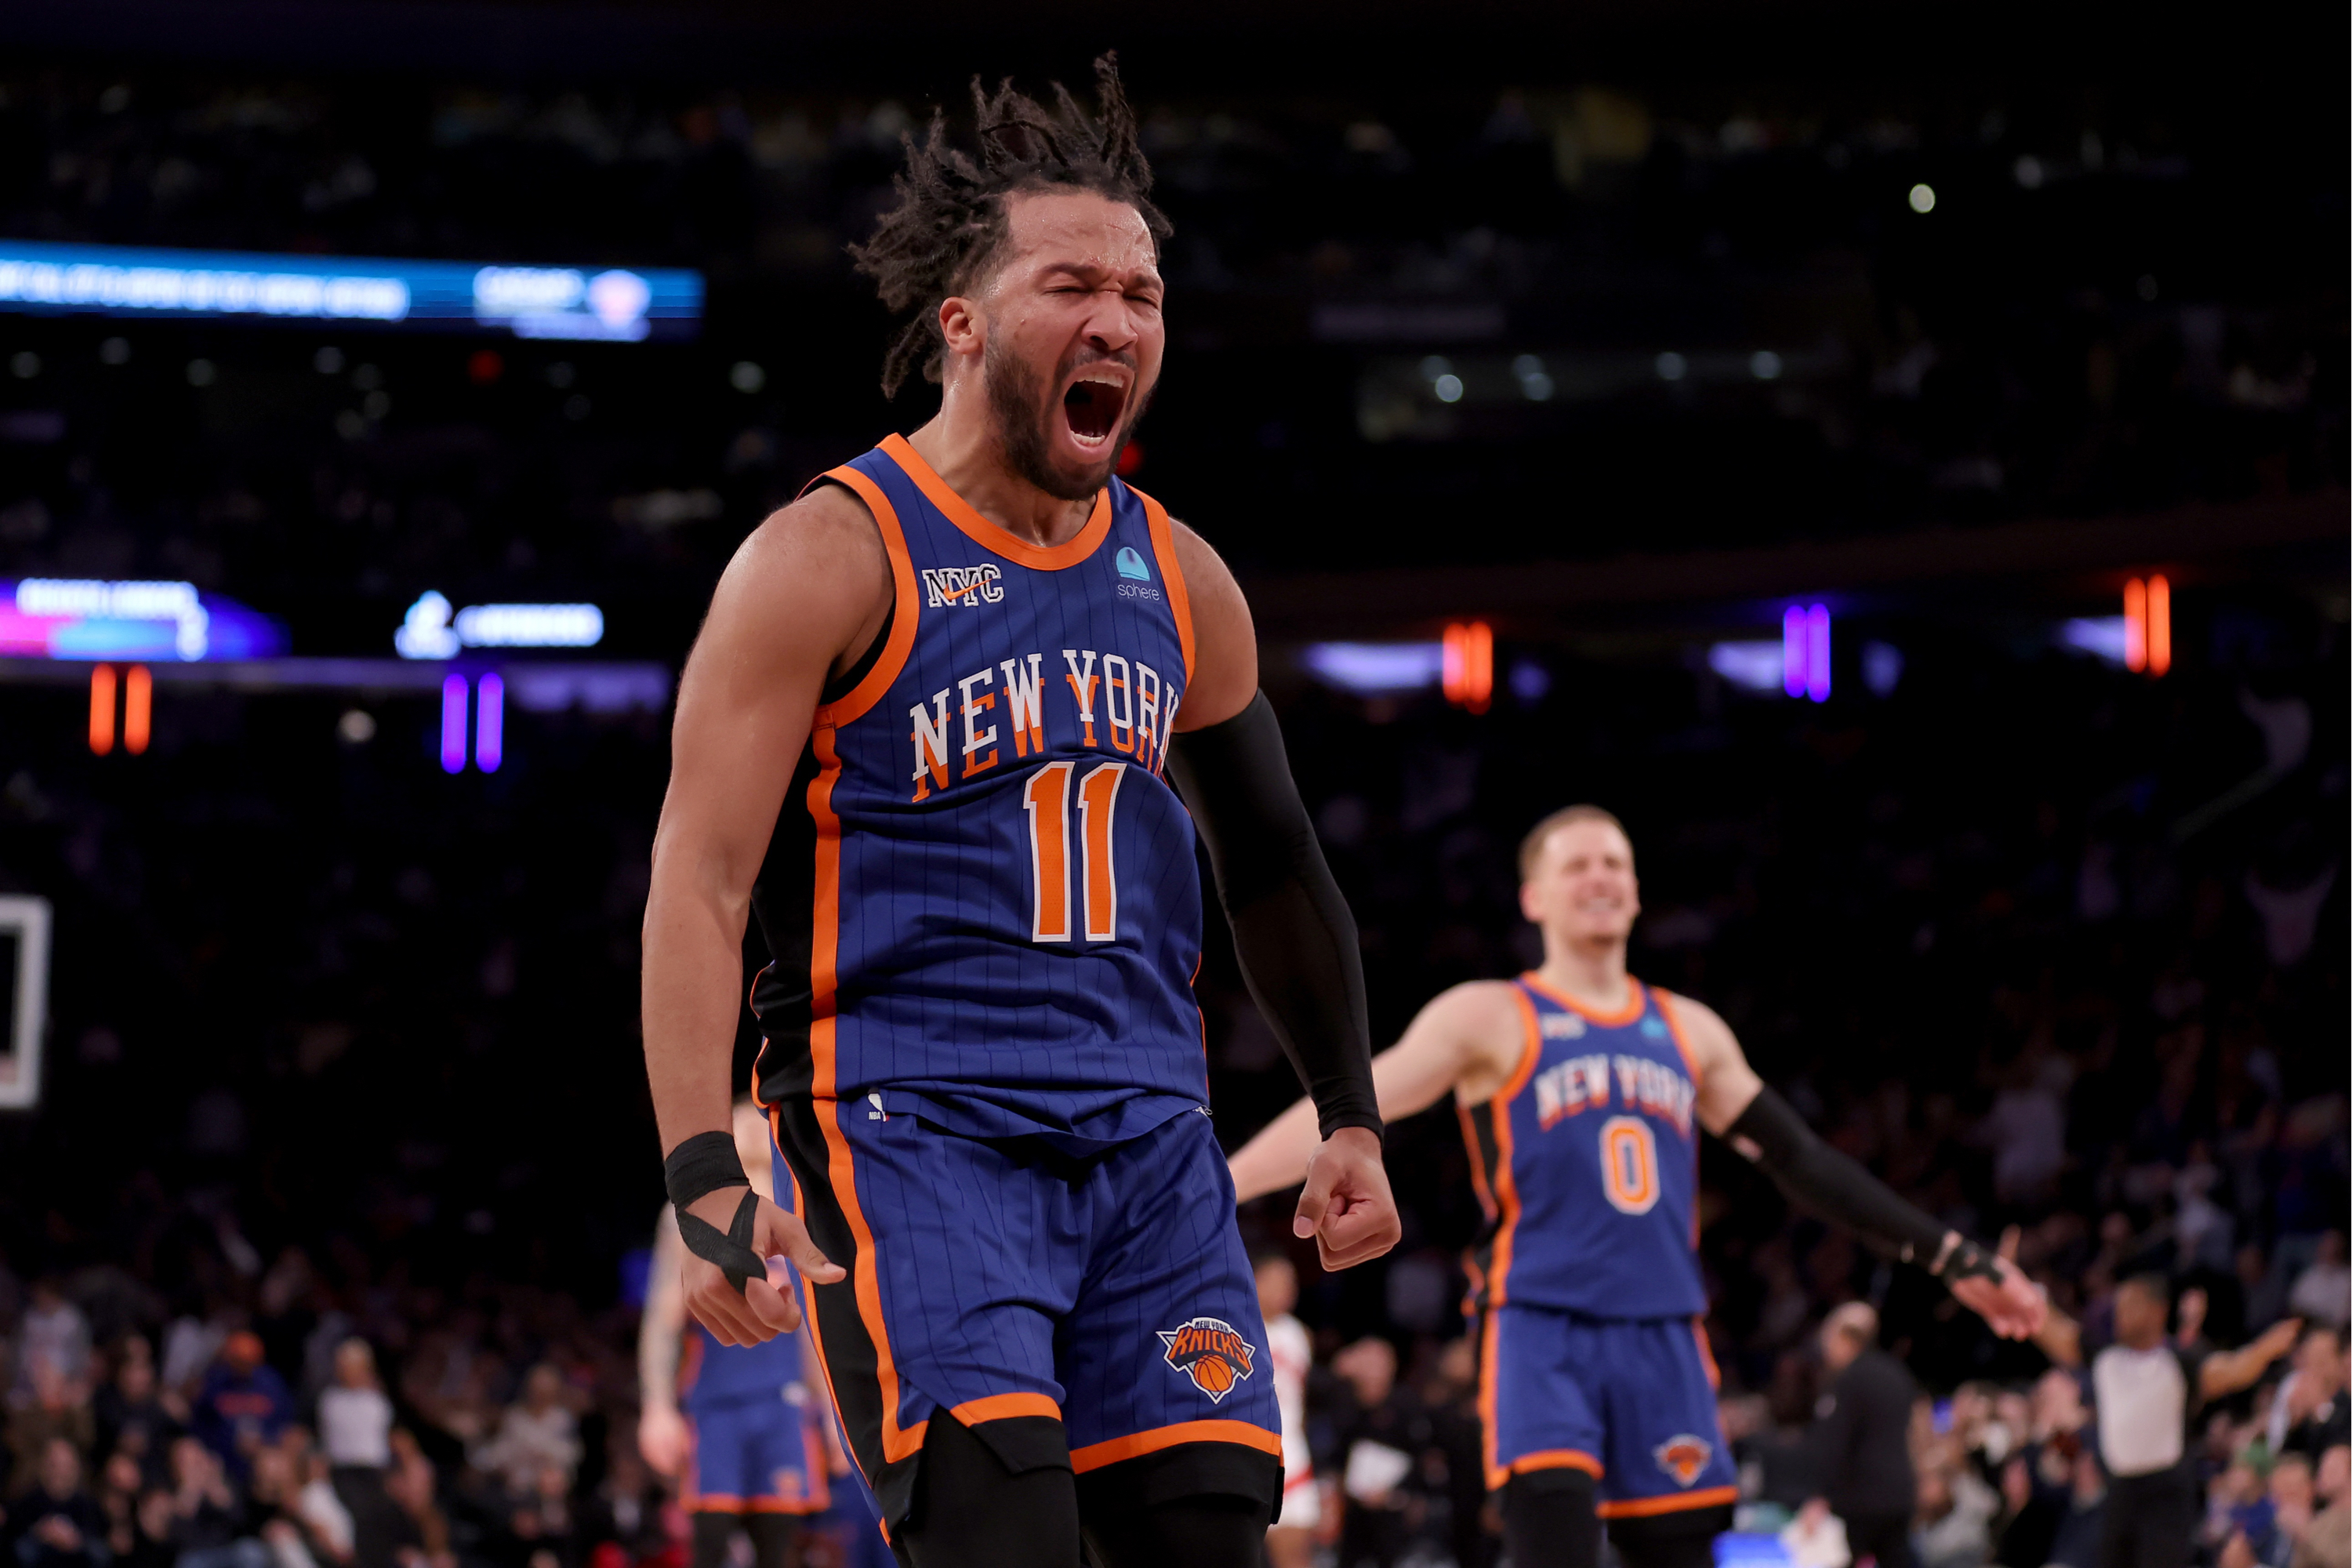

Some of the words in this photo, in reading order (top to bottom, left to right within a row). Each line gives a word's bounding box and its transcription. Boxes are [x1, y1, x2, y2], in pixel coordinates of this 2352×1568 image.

[921, 563, 1004, 608] NYC
[1117, 583, 1160, 601] sphere
[909, 653, 1044, 802] NEW
[1062, 649, 1180, 778] YORK
[1023, 761, 1127, 942] 11
[869, 1111, 881, 1120] NBA
[1535, 1053, 1609, 1131] NEW
[1612, 1053, 1695, 1137] YORK
[1599, 1114, 1661, 1215] 0
[1168, 1327, 1251, 1371] KNICKS
[1194, 1320, 1210, 1330] NEW
[1211, 1320, 1229, 1334] YORK
